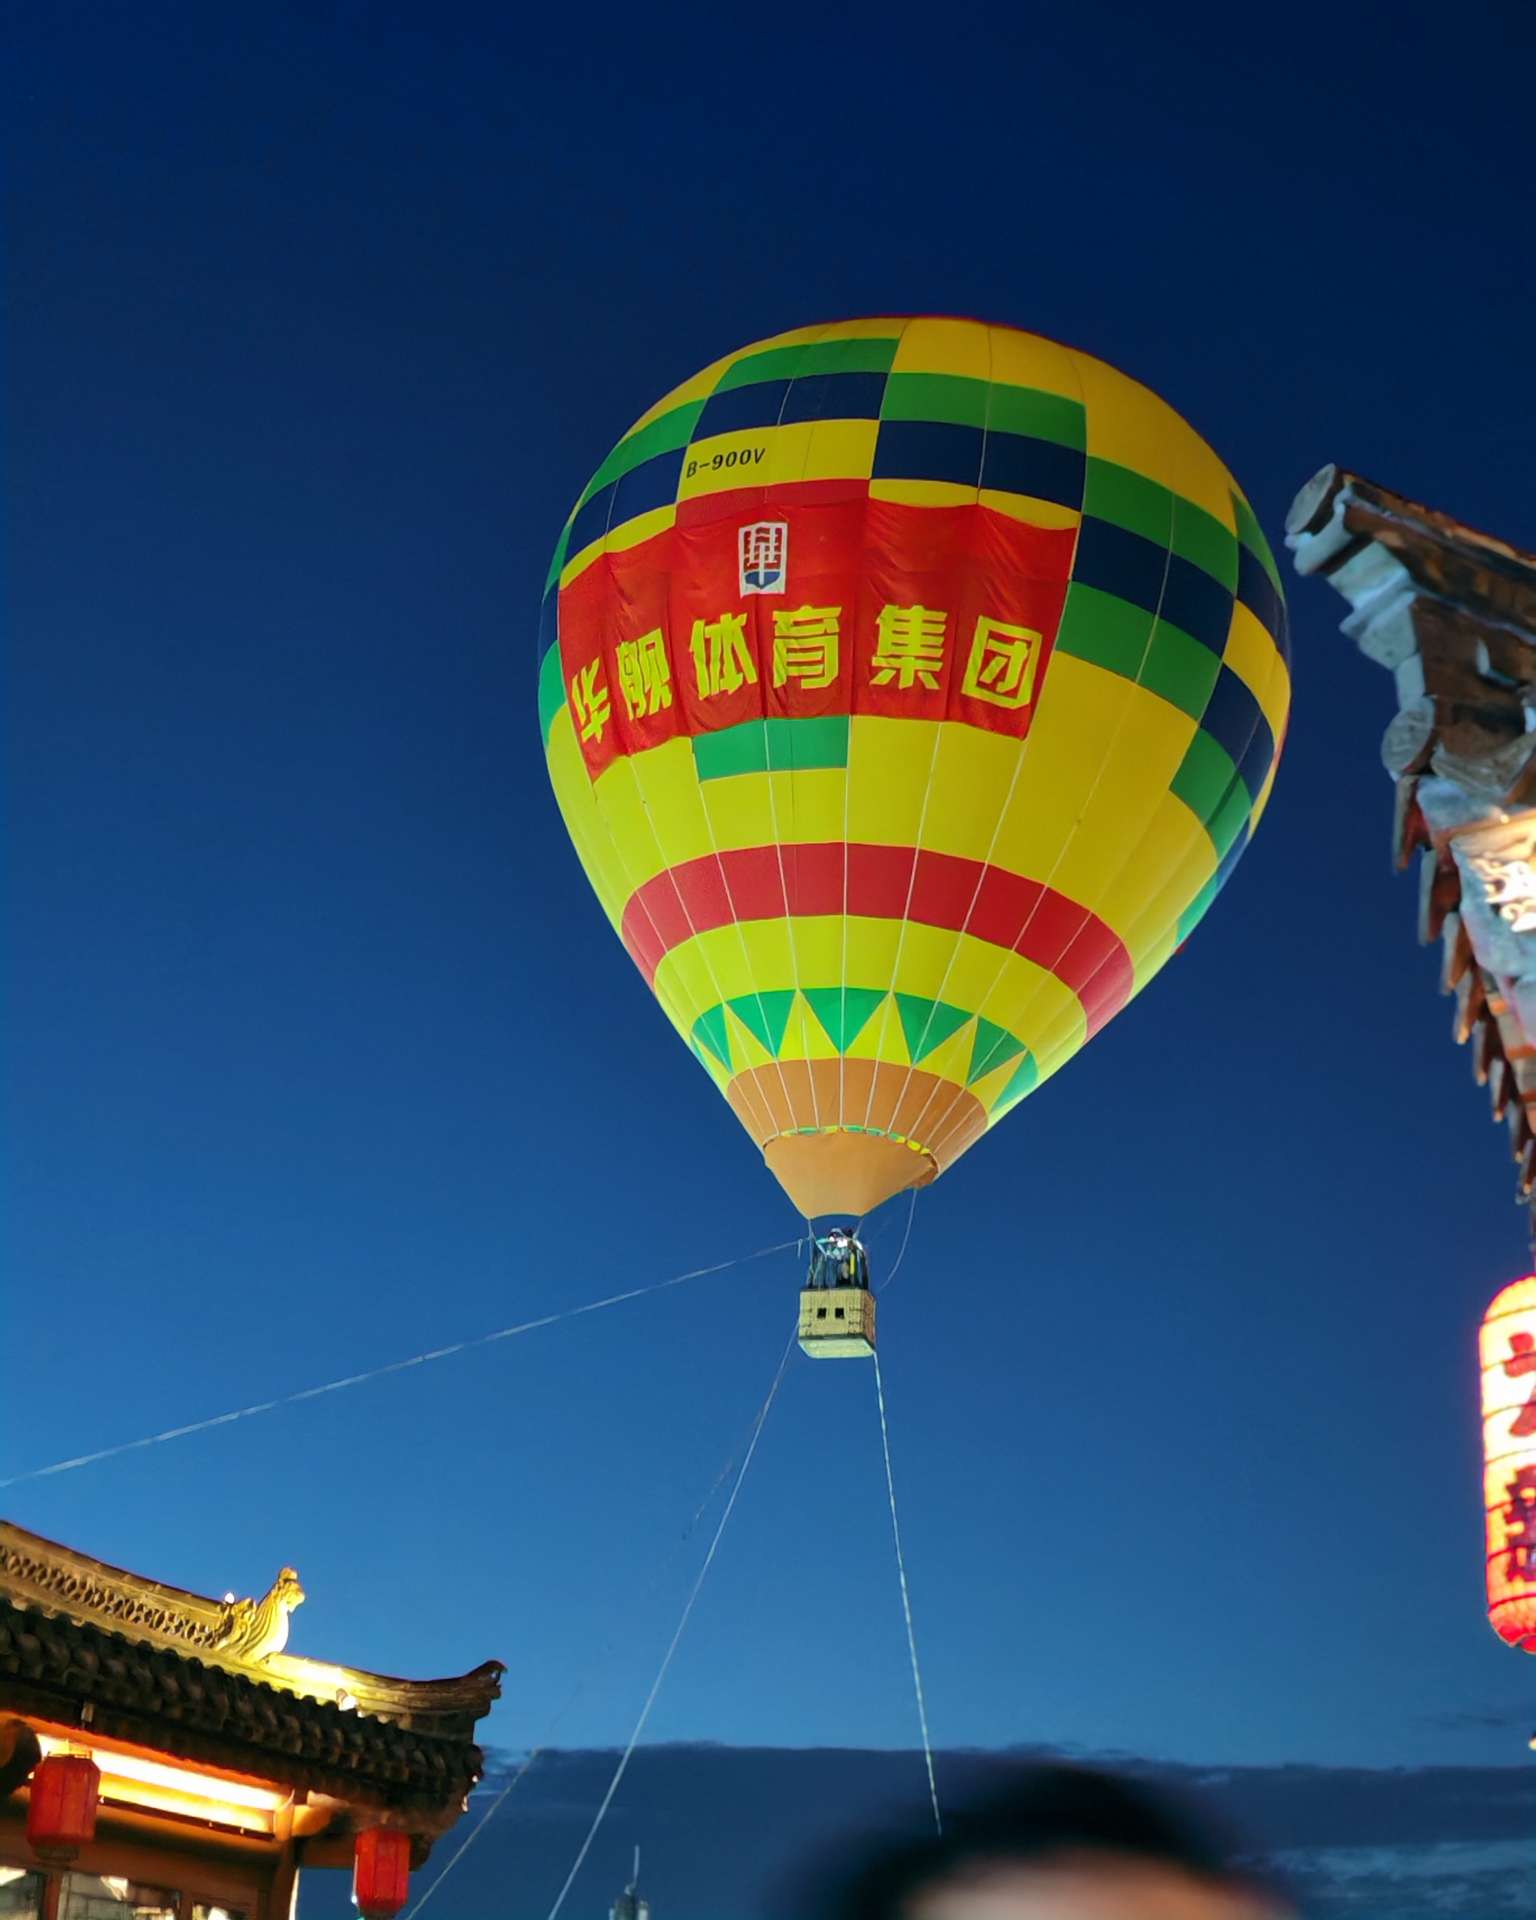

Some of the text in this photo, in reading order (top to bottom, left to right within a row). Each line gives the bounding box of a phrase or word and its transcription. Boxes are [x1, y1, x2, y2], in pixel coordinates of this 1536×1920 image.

[686, 447, 766, 478] B-900V
[571, 604, 1043, 744] 华舰体育集团
